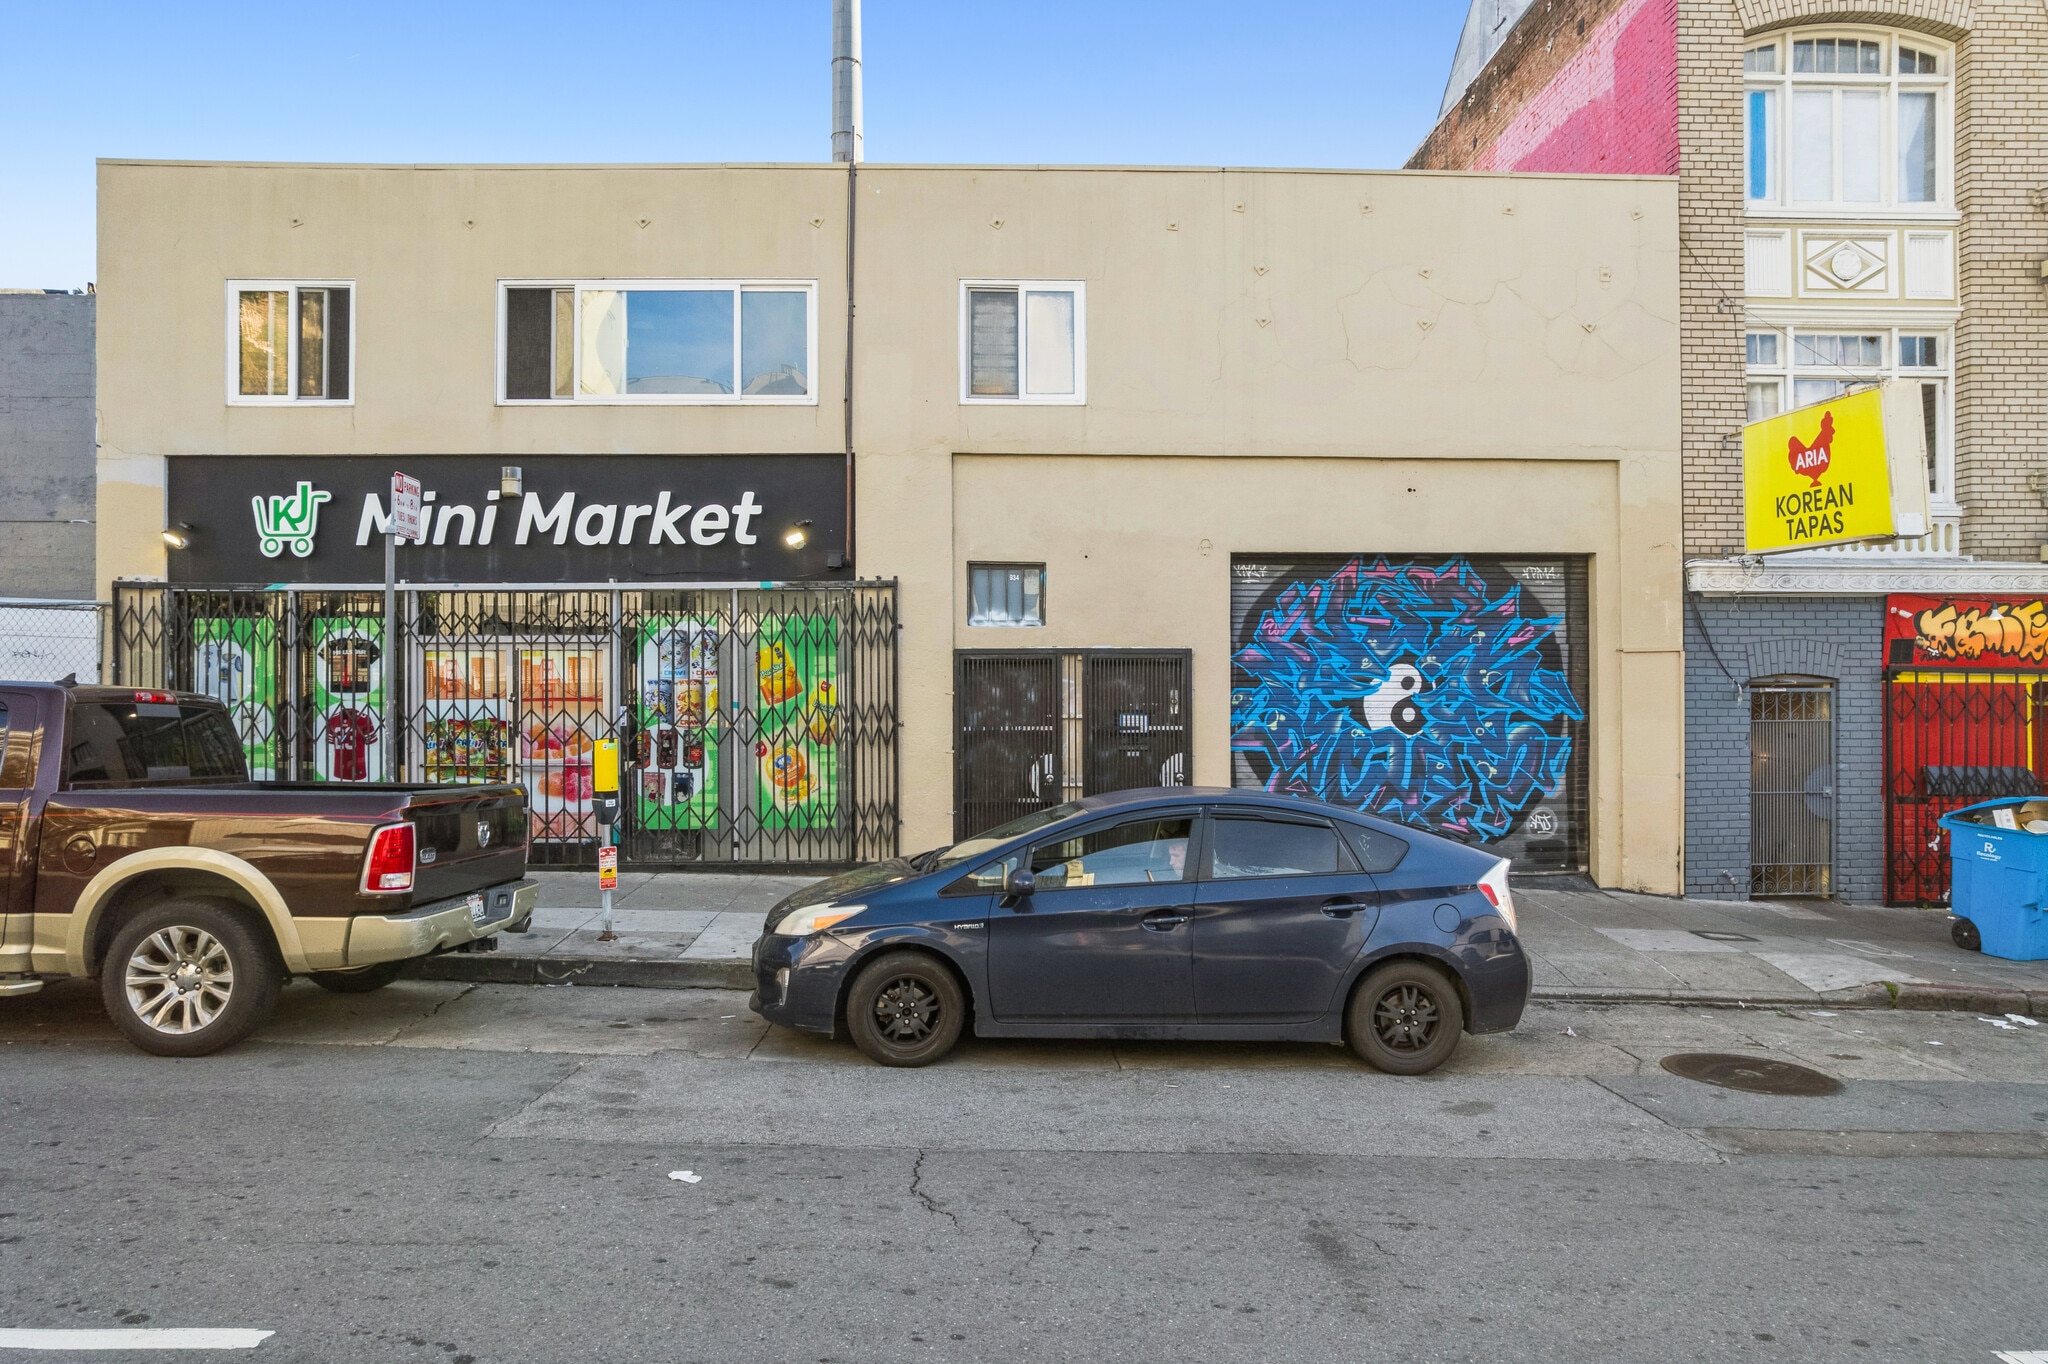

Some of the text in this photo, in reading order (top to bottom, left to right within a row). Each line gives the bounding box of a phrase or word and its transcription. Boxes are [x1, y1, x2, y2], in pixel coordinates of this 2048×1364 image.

[1795, 447, 1828, 470] ARIA
[404, 482, 419, 497] PARKING
[1776, 482, 1853, 518] KOREAN
[355, 490, 762, 546] Mini Market
[1786, 511, 1844, 540] TAPAS
